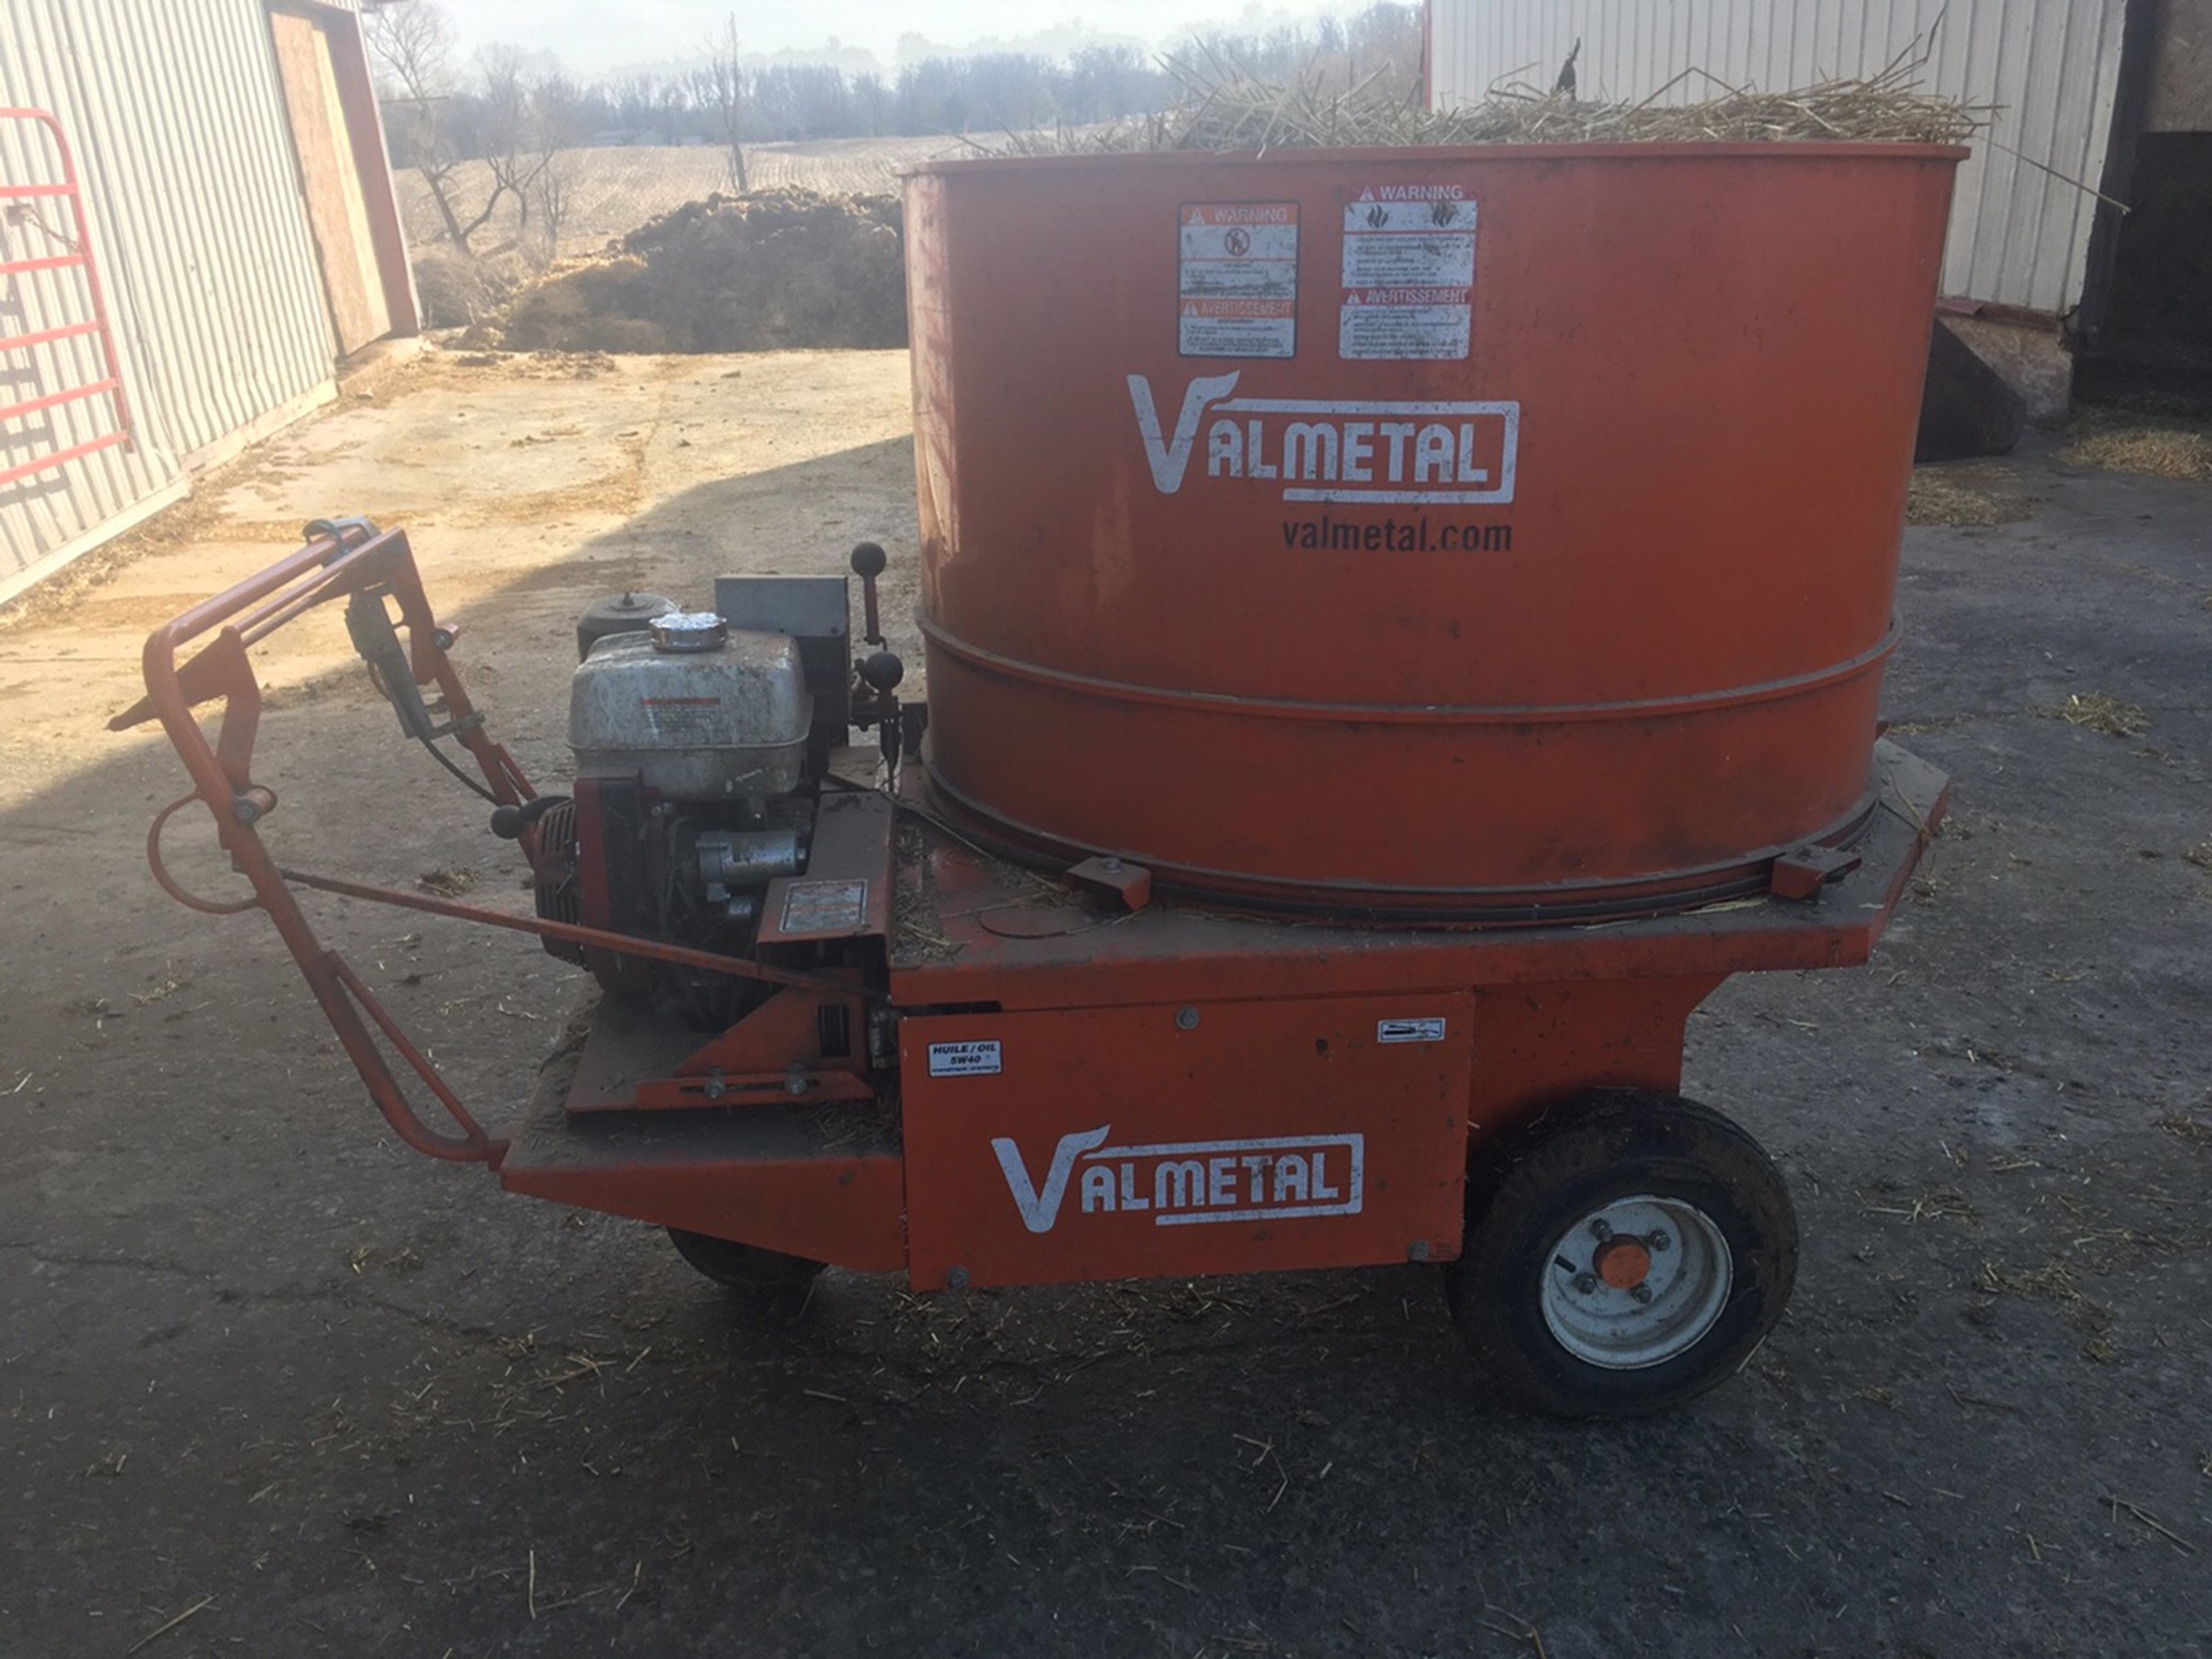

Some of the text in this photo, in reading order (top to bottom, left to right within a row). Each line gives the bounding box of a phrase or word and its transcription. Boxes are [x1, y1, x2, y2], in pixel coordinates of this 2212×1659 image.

[1380, 185, 1464, 200] WARNING
[1214, 207, 1288, 222] WARNING
[1366, 288, 1468, 304] AVERTISSEMENT
[1200, 300, 1291, 316] AVERTISSEMENT
[1126, 371, 1488, 494] VALMETAL
[1282, 516, 1512, 552] valmetal.com
[933, 1044, 969, 1054] HUILE
[977, 1042, 996, 1053] OIL
[991, 1124, 1339, 1233] VALMETAL
